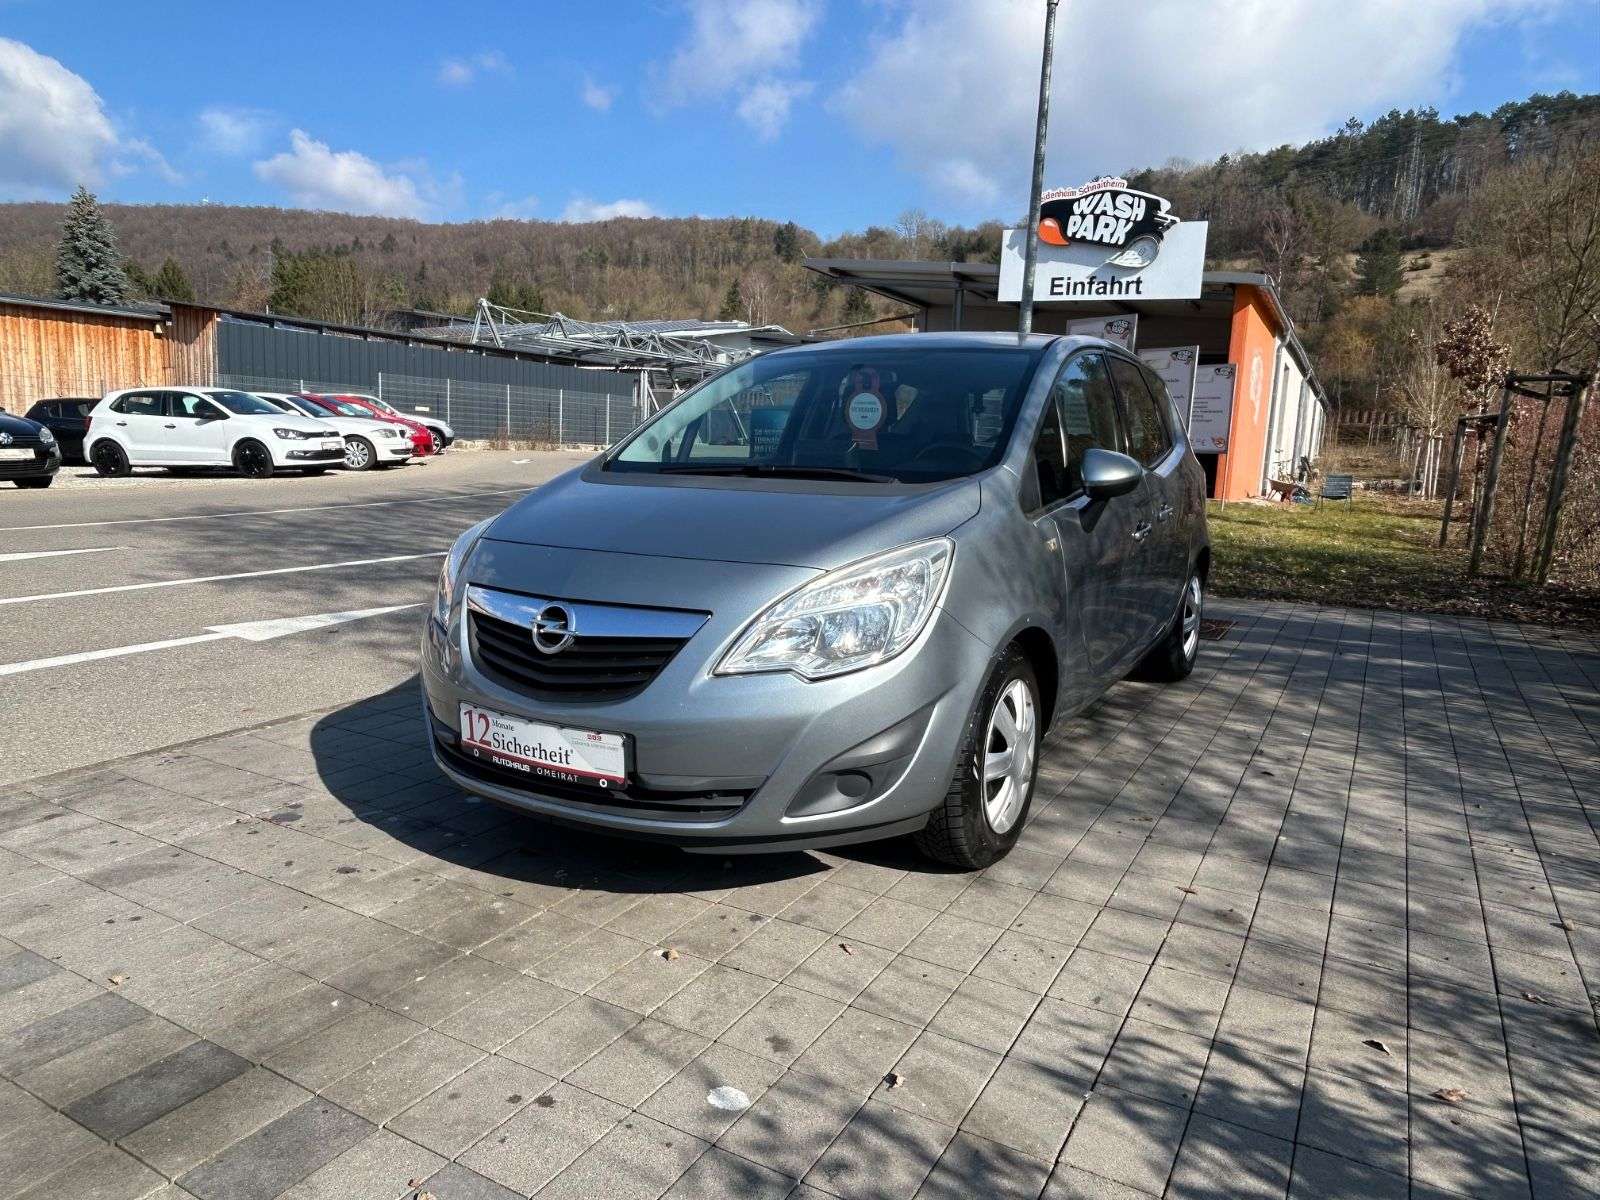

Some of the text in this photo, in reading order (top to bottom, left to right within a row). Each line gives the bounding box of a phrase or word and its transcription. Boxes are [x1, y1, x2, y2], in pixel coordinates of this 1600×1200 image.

[1079, 178, 1125, 196] Schnaitheim
[1072, 192, 1147, 222] WASH
[1066, 215, 1134, 245] PARK
[1050, 276, 1143, 296] Einfahrt
[464, 709, 492, 748] 12
[492, 719, 515, 732] Monate
[492, 756, 579, 783] AUTOHAUS OMEIRAT
